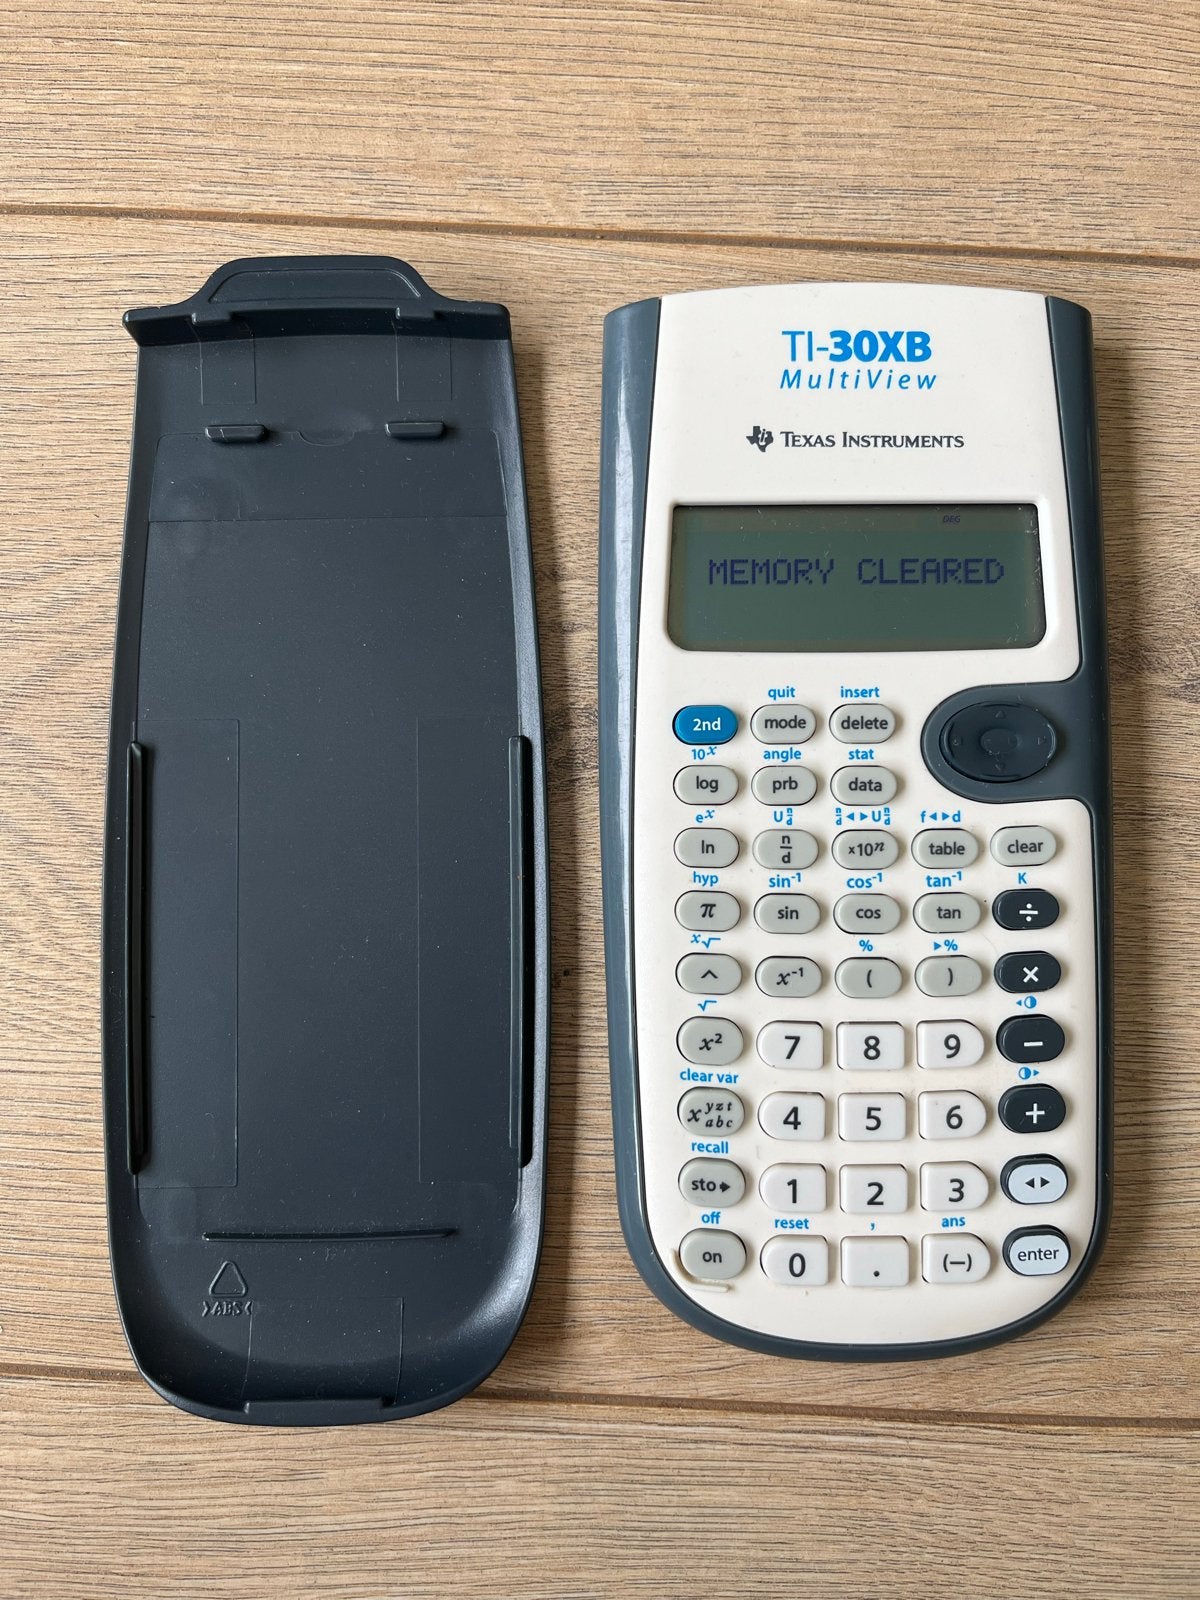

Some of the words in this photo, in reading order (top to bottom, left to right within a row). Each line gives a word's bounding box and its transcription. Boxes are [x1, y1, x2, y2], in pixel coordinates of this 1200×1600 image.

[782, 330, 932, 362] TI-30XB
[780, 368, 936, 389] MultiView
[780, 432, 835, 447] TEXAS
[843, 432, 964, 448] INSTRUMENTS
[942, 514, 961, 524] DEG
[709, 559, 834, 584] MEMORY
[858, 559, 1004, 584] CLEARED
[768, 686, 795, 700] quit
[841, 686, 879, 698] insert
[693, 718, 720, 731] 2nd
[765, 716, 806, 729] mode
[841, 716, 888, 729] delete
[764, 747, 801, 762] angle
[849, 749, 874, 760] stat
[696, 776, 718, 793] log
[773, 776, 798, 793] prb
[849, 777, 882, 791] data
[702, 840, 714, 853] ln
[929, 842, 965, 855] table
[1008, 840, 1043, 853] clear
[693, 871, 718, 886] hyp
[1018, 873, 1026, 884] K
[778, 906, 798, 919] sin
[856, 909, 881, 919] cos
[937, 907, 961, 919] tan
[859, 940, 873, 951] %
[944, 940, 958, 951] %
[785, 1036, 800, 1059] 7
[864, 1036, 880, 1060] 8
[944, 1034, 960, 1058] 9
[680, 1069, 713, 1082] clear
[717, 1074, 738, 1083] var
[783, 1107, 801, 1130] 4
[866, 1107, 881, 1131] 5
[946, 1105, 963, 1129] 6
[692, 1141, 728, 1153] recall
[692, 1179, 716, 1191] sto
[787, 1179, 797, 1203] 1
[949, 1179, 964, 1202] 3
[867, 1182, 884, 1205] 2
[702, 1211, 720, 1224] off
[775, 1219, 809, 1229] reset
[942, 1217, 965, 1227] ans
[703, 1252, 722, 1263] on
[1018, 1248, 1059, 1261] enter
[789, 1253, 805, 1277] 0
